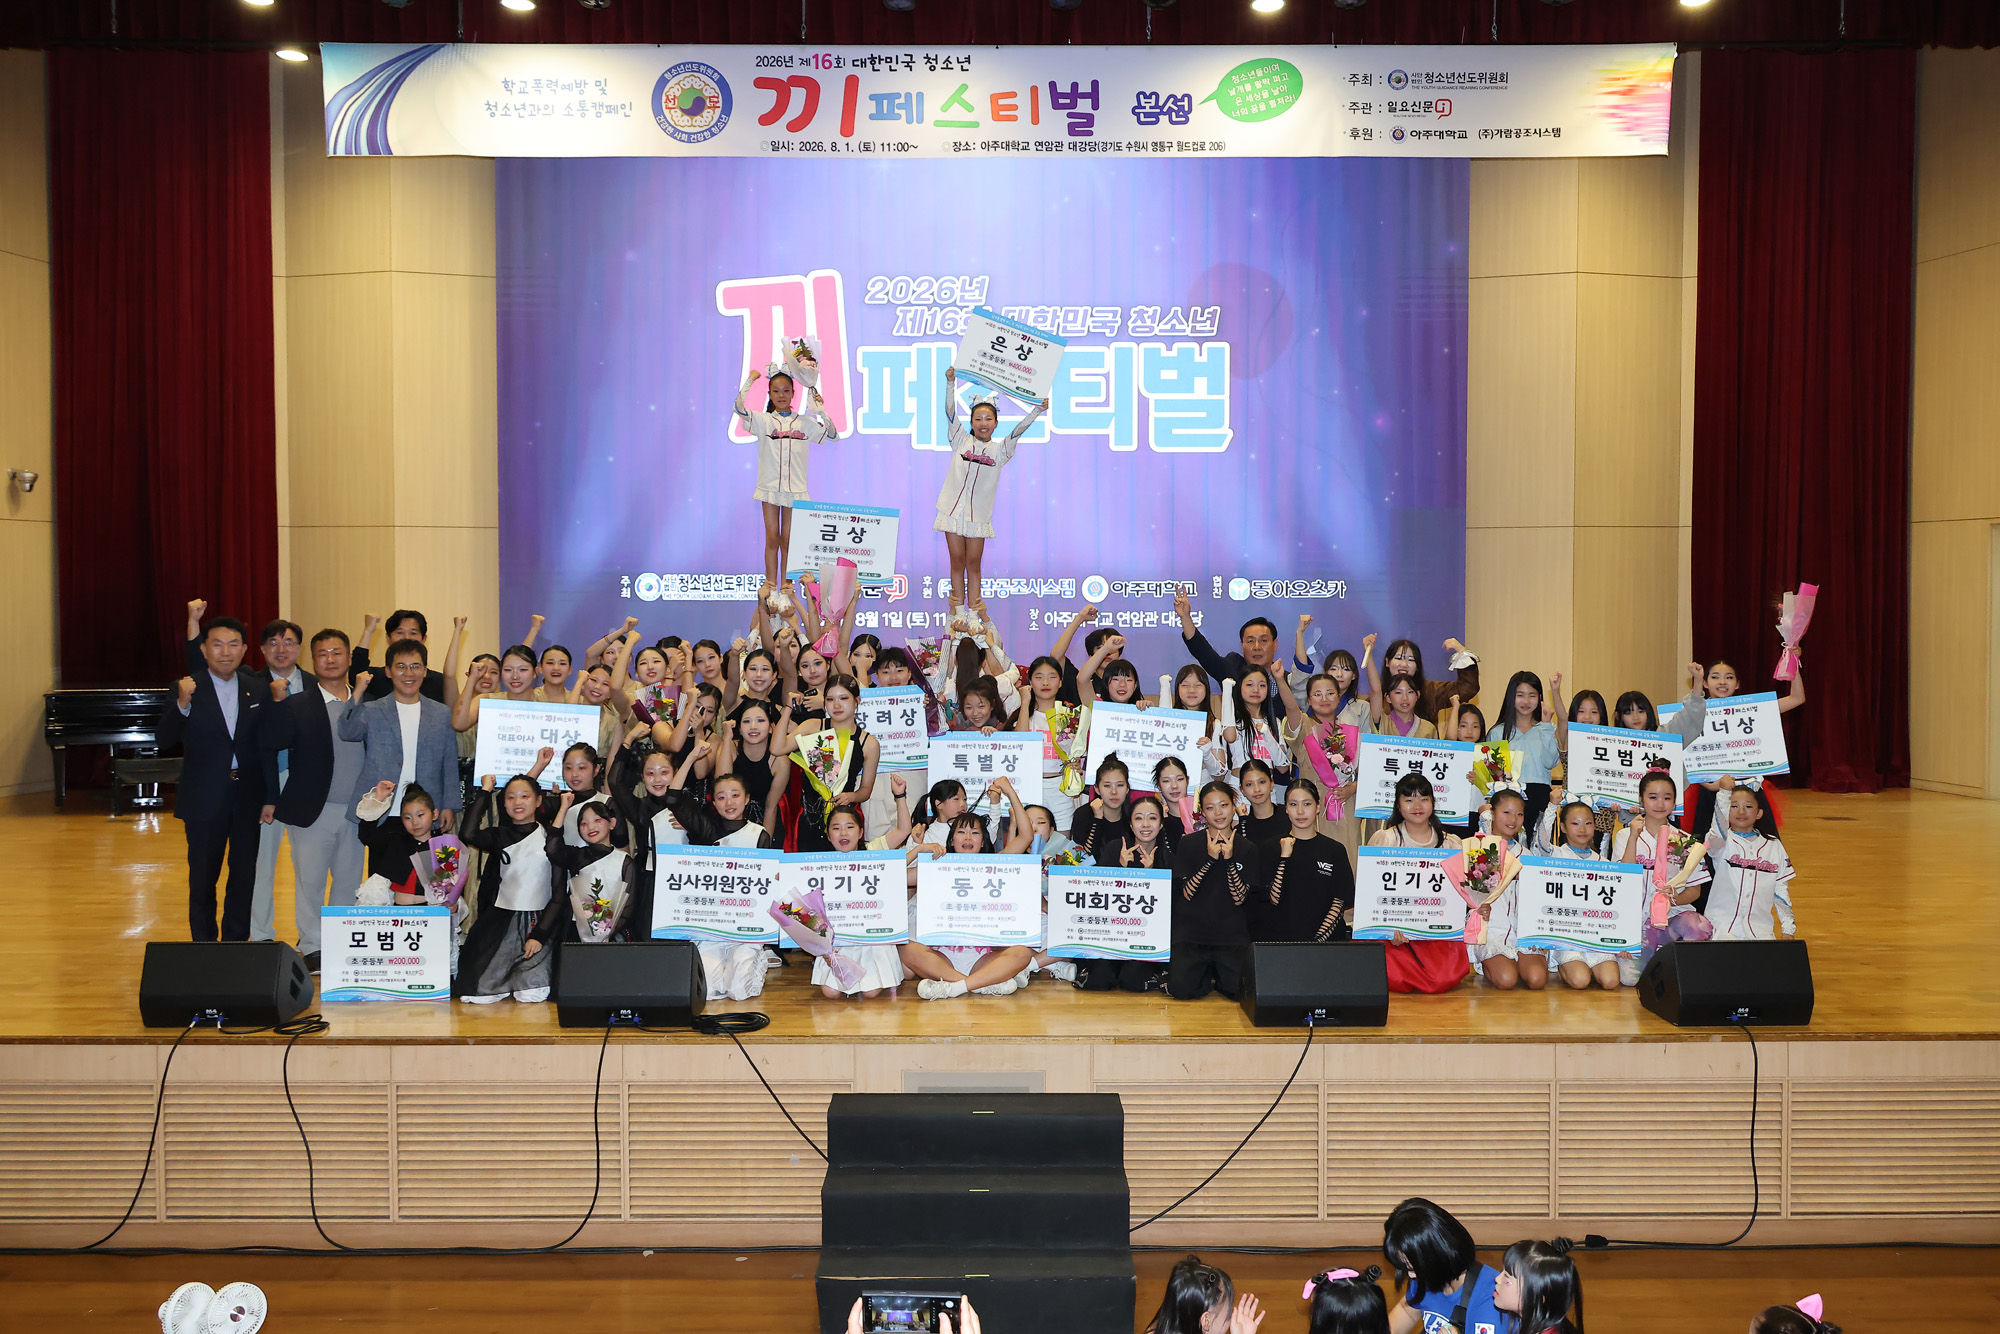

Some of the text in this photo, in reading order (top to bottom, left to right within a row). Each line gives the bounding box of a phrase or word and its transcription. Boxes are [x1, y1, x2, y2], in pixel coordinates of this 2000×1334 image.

[755, 53, 972, 72] 2026년 제16회 대한민국 청소년
[1231, 63, 1281, 84] 청소년들이여
[1348, 72, 1509, 87] 주최 청소년선도위원회
[501, 77, 608, 96] 학교폭력예방 및
[485, 100, 632, 118] 청소년과의 소통캠페인
[1131, 91, 1193, 126] 본선
[1231, 106, 1249, 118] 너의
[1348, 101, 1434, 115] 주관 일요신문
[1349, 127, 1562, 141] 후원 아주대학교 (주)가람공조시스템
[770, 141, 794, 152] 일시:
[799, 142, 827, 152] 2026.
[830, 142, 841, 152] 8.
[845, 142, 855, 152] 1.
[858, 141, 876, 153] (토)
[952, 141, 976, 152] 장소:
[980, 141, 1031, 152] 아주대학교
[1034, 141, 1064, 152] 연암관
[1125, 141, 1149, 152] 수원시
[1151, 141, 1174, 152] 영통구
[1176, 141, 1206, 152] 월드컵로
[1208, 141, 1226, 152] 206)
[864, 275, 990, 305] 2026년
[1127, 305, 1221, 337] 청소년
[858, 341, 1234, 453] 페티벌
[620, 575, 631, 599] 주최
[1111, 580, 1198, 598] 아주대학교
[1251, 579, 1347, 599] 동아오츠카
[855, 611, 947, 629] 8월 1일 (토) 11
[1028, 608, 1040, 631] 장소
[1116, 611, 1159, 628] 연암관
[497, 728, 582, 748] 대표이사 대상
[888, 731, 916, 740] ₩200,000
[1104, 727, 1189, 752] 퍼포먼스상
[1725, 739, 1756, 748] ₩200,000
[666, 873, 771, 895] 심사위원장상
[720, 898, 751, 907] ₩300,000
[846, 900, 878, 909] ₩200,000
[981, 903, 1012, 912] ₩300,000
[1065, 891, 1158, 915] 대회장상
[1413, 897, 1442, 906] ₩200,000
[1111, 917, 1142, 926] ₩500,000
[1582, 910, 1613, 919] ₩200,000
[388, 957, 420, 965] ₩200,000
